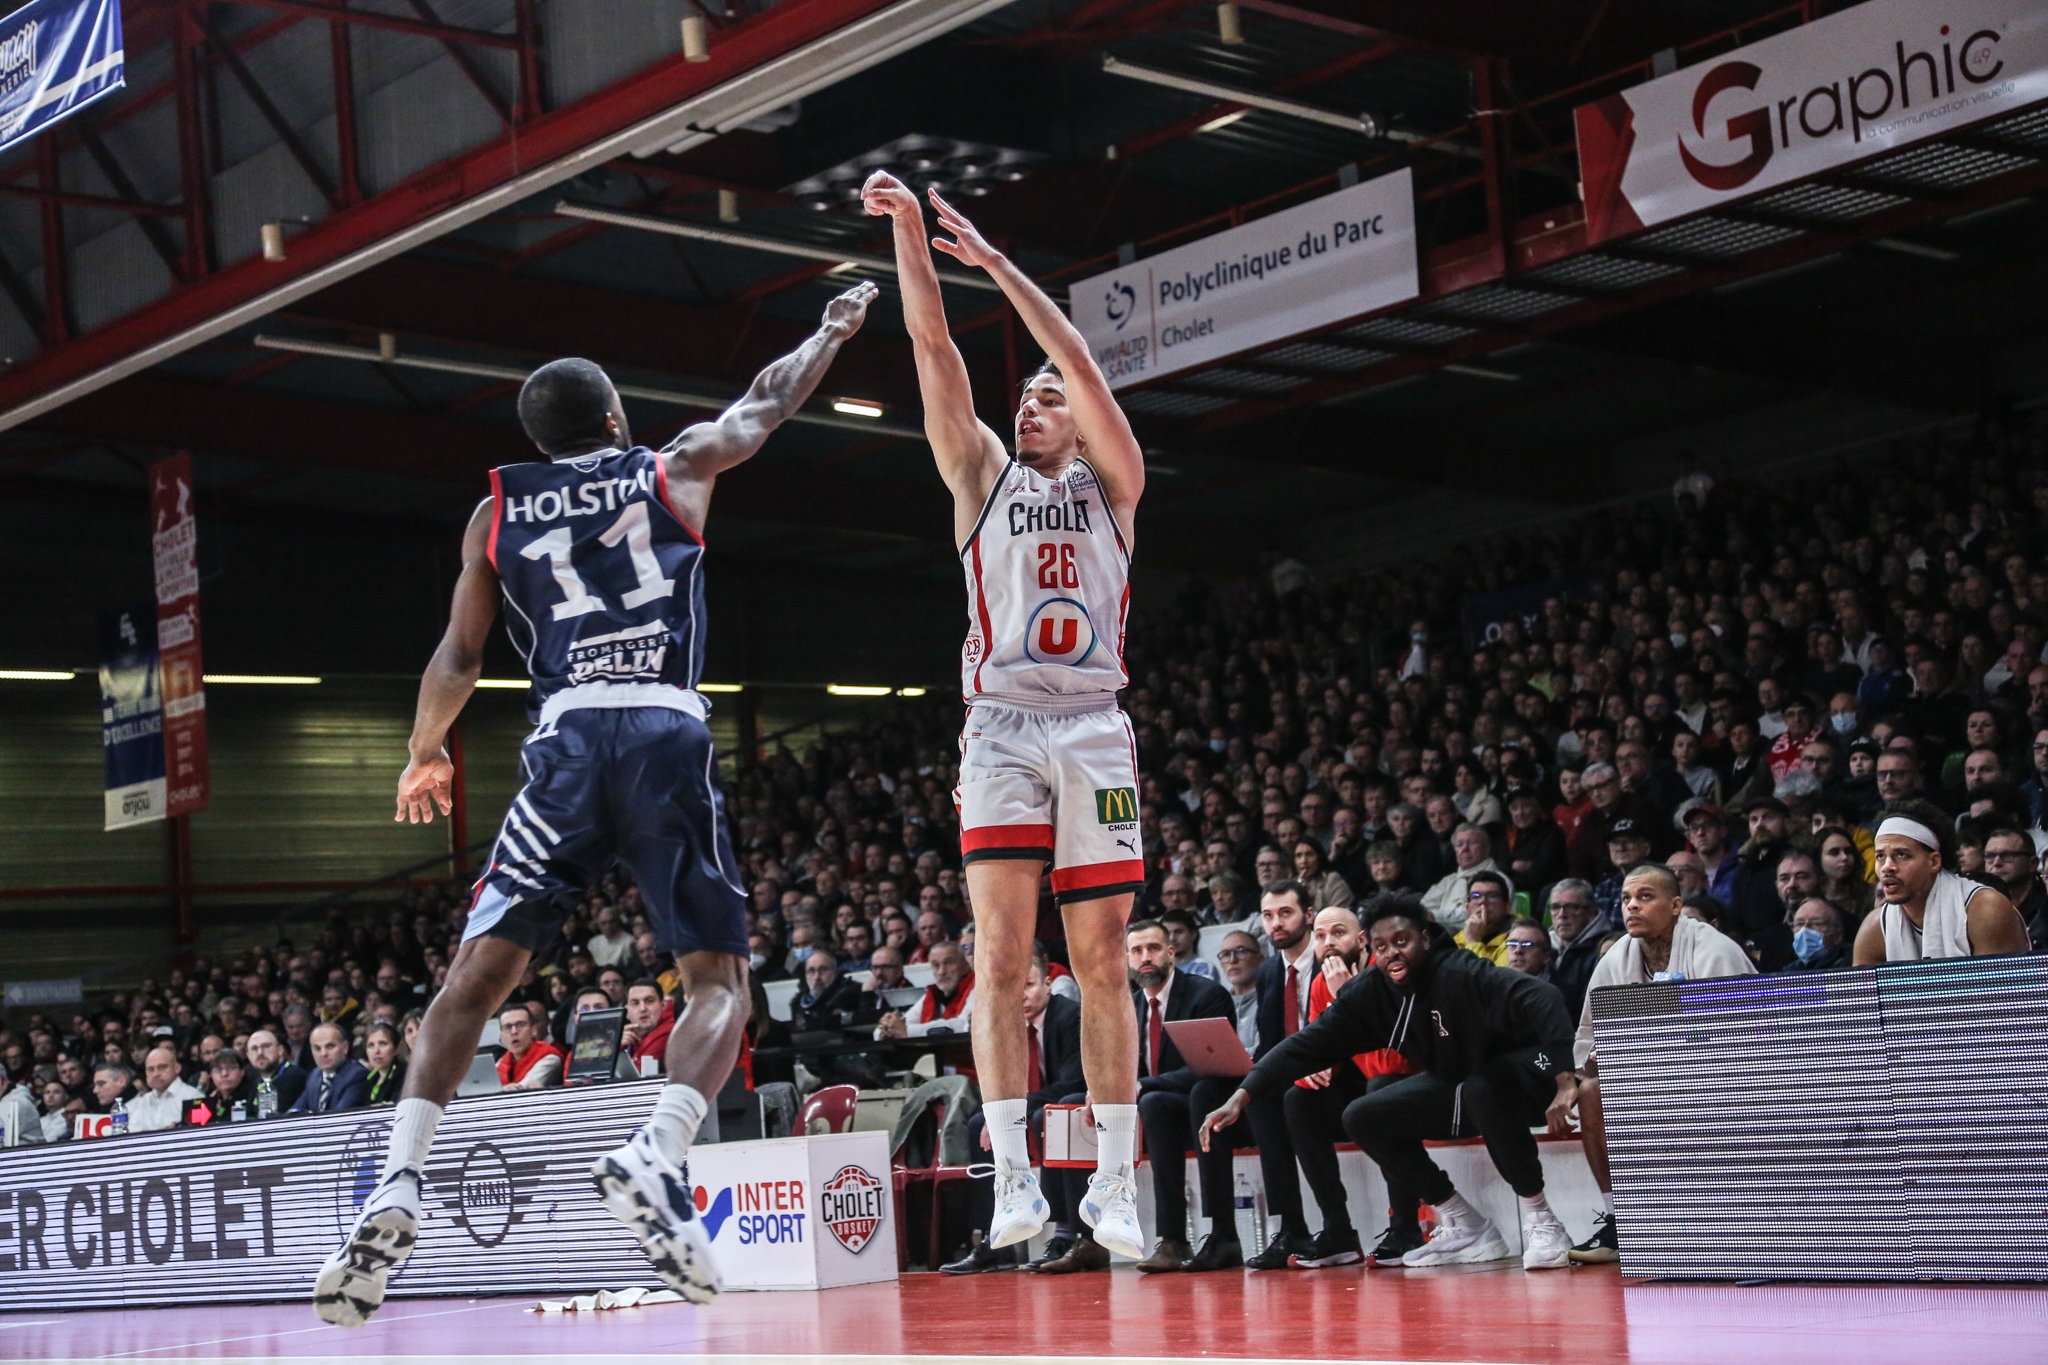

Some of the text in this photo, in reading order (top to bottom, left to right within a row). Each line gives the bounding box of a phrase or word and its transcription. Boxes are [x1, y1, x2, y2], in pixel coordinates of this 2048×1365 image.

[1972, 47, 1991, 65] 49
[1677, 24, 2004, 190] Graphic
[1865, 81, 2016, 139] la communication visuelle
[1159, 214, 1383, 305] Polyclinique du Parc
[1161, 316, 1214, 348] Cholet
[1008, 499, 1093, 537] CHOLET
[519, 501, 676, 622] 11
[1038, 543, 1079, 590] 26
[1038, 617, 1078, 655] U
[1108, 823, 1137, 832] CHOLET
[466, 1181, 508, 1209] MINI
[737, 1180, 804, 1212] INTER
[822, 1186, 883, 1223] CHOLET
[64, 1165, 285, 1271] CHOLET
[739, 1213, 805, 1245] SPORT
[837, 1220, 873, 1236] BASKET
